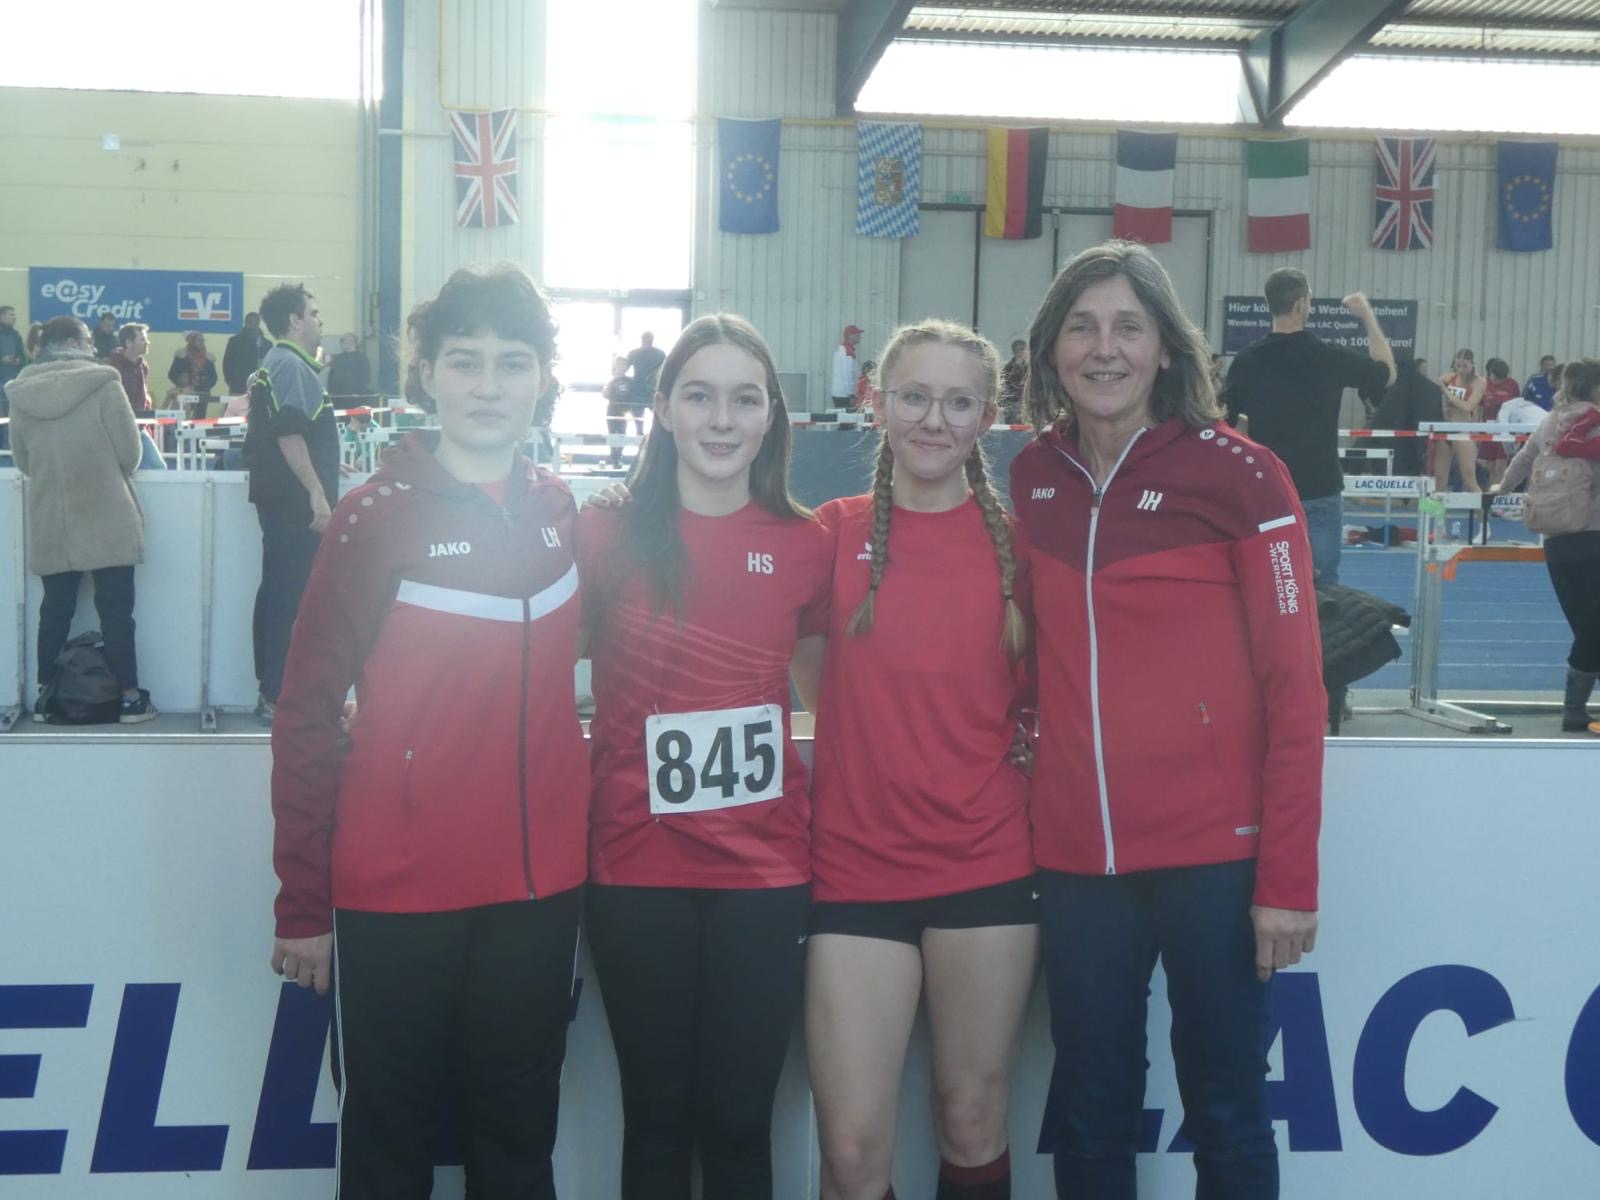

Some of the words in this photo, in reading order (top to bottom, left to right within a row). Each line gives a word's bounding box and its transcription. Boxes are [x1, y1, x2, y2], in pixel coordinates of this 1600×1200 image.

[41, 280, 106, 303] e@sy
[72, 299, 144, 319] Credit
[1228, 302, 1251, 312] Hier
[1374, 306, 1408, 316] tehen!
[1031, 487, 1055, 500] JAKO
[1355, 480, 1373, 489] LAC
[1376, 480, 1415, 490] QUELLE
[1491, 496, 1521, 506] UELLE
[429, 541, 471, 557] JAKO
[747, 552, 774, 574] HS
[1275, 541, 1293, 577] SPORT
[1284, 578, 1299, 614] KÖNIG
[655, 720, 776, 804] 845
